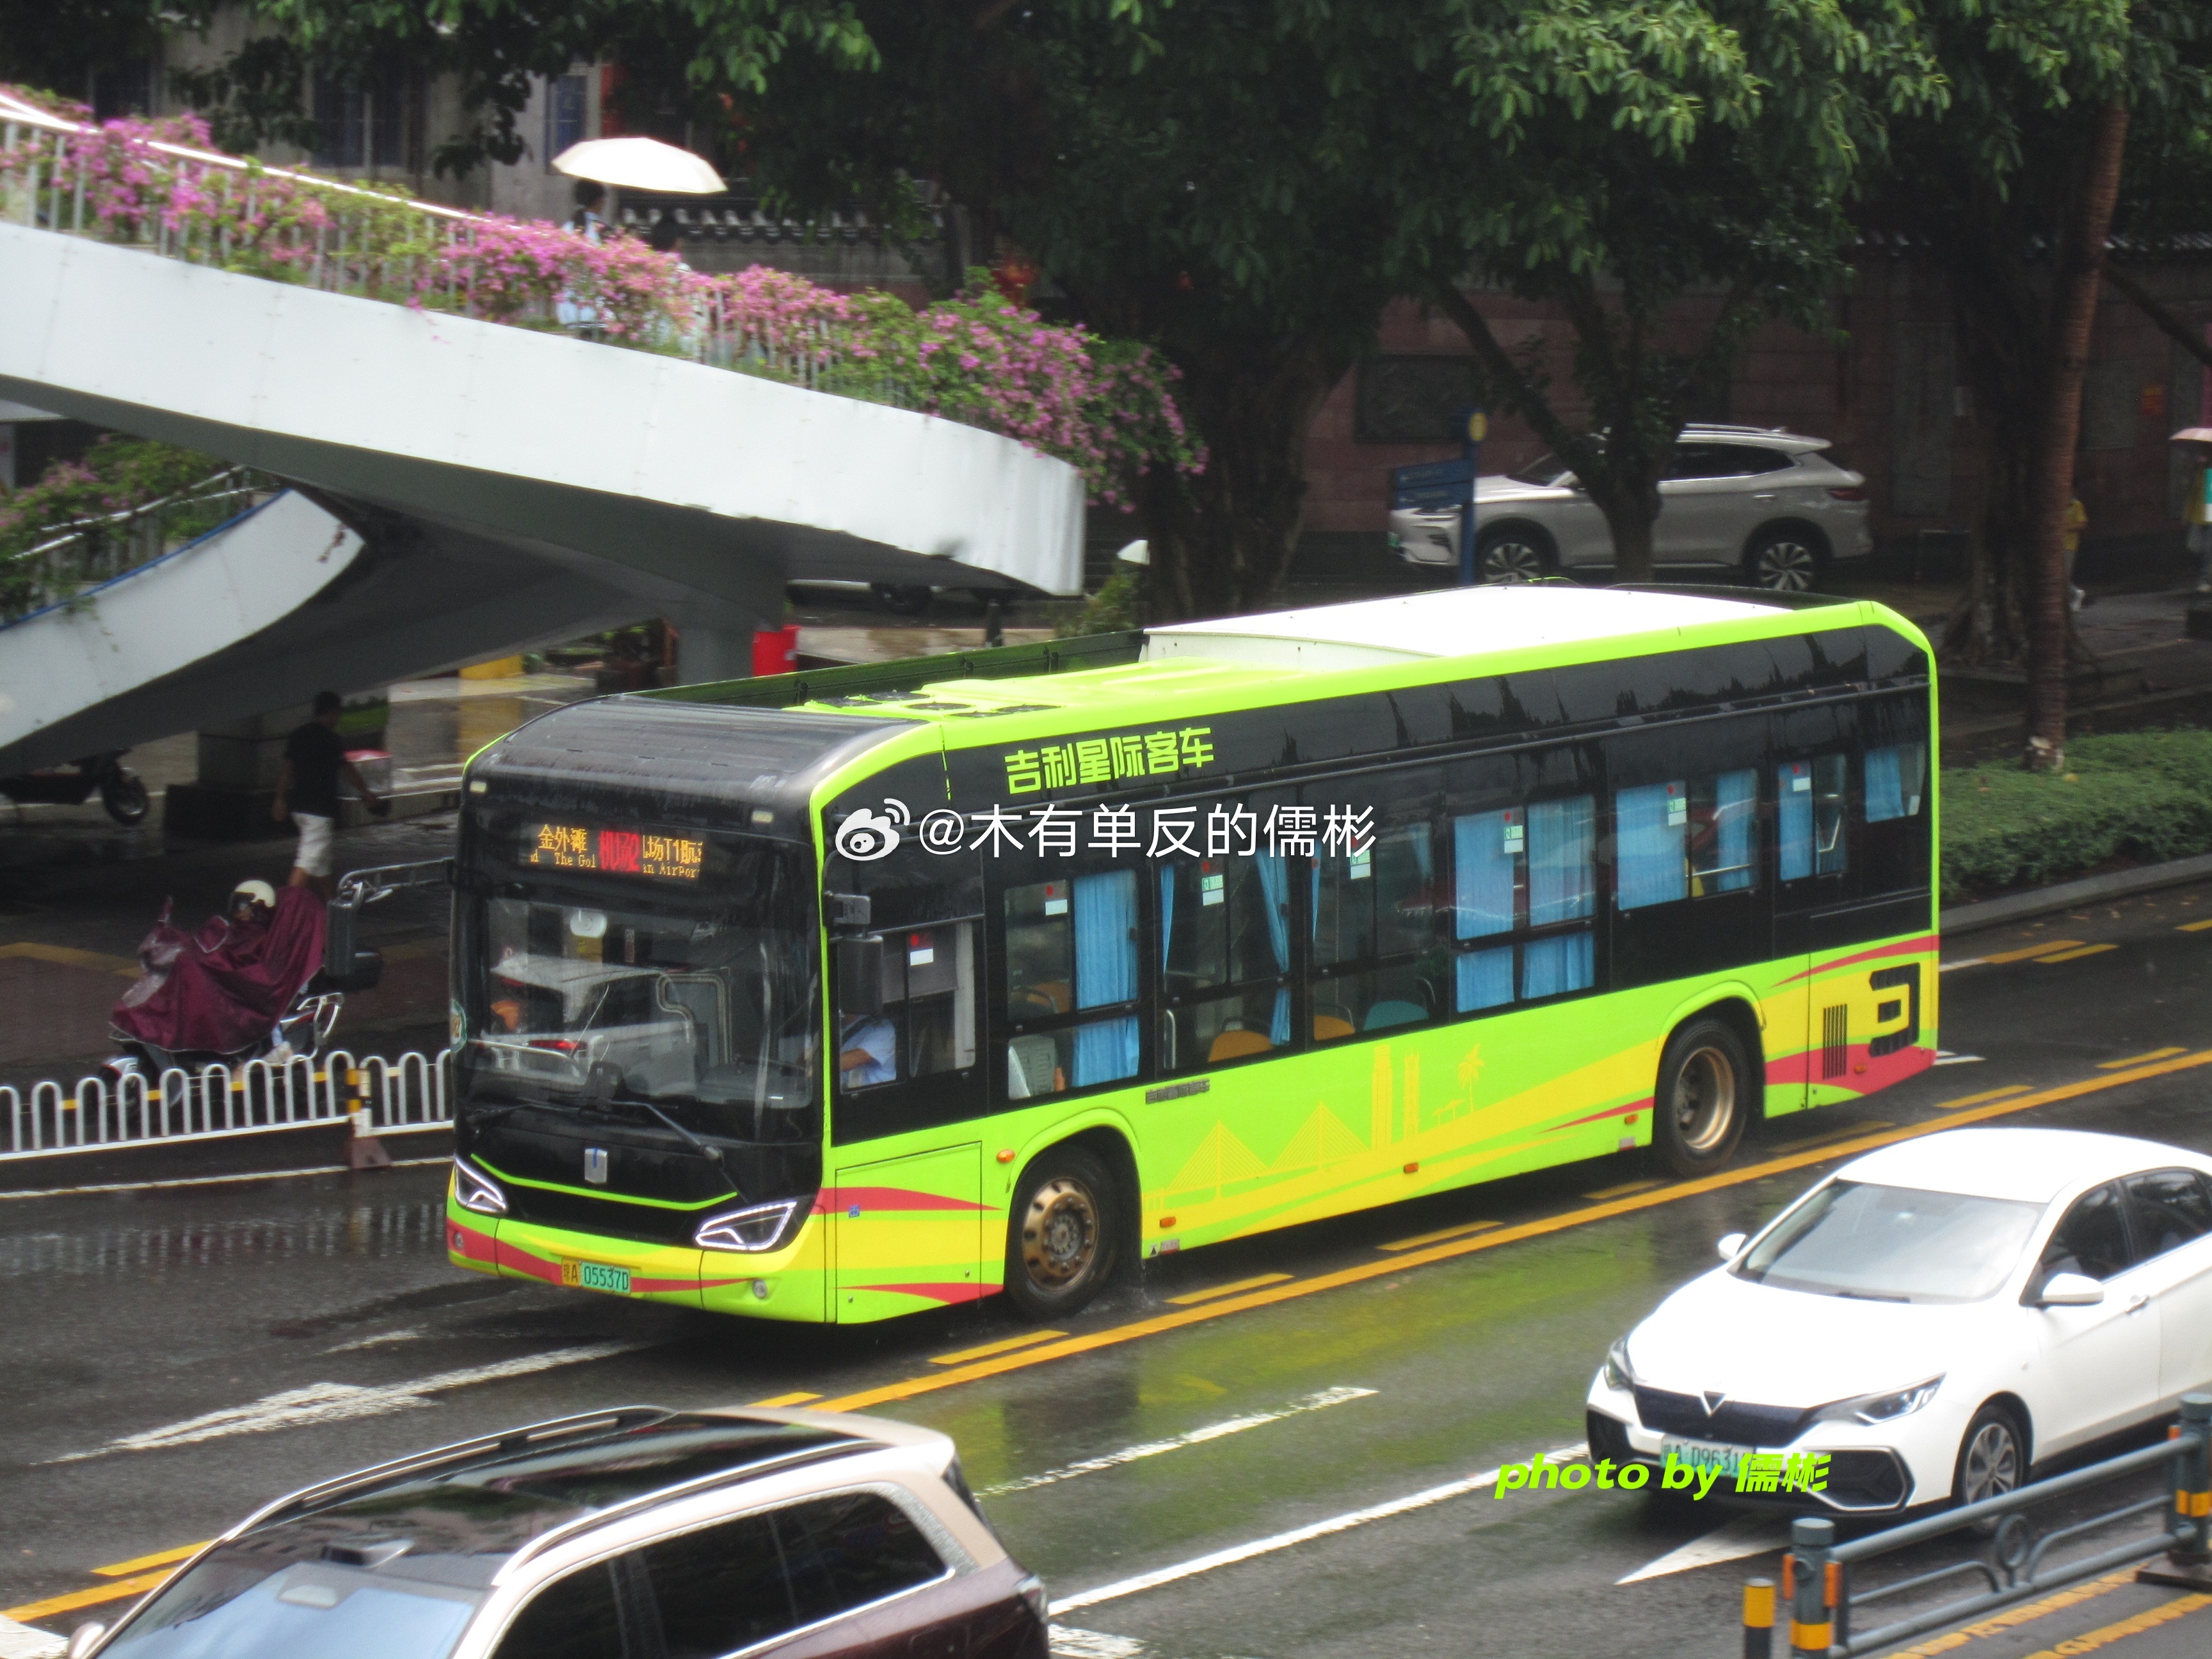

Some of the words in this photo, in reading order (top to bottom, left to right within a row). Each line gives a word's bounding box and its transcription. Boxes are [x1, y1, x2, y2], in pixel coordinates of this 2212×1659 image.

[1004, 727, 1214, 794] 吉利星际客车
[554, 851, 573, 866] The
[642, 835, 703, 864] 场T1航
